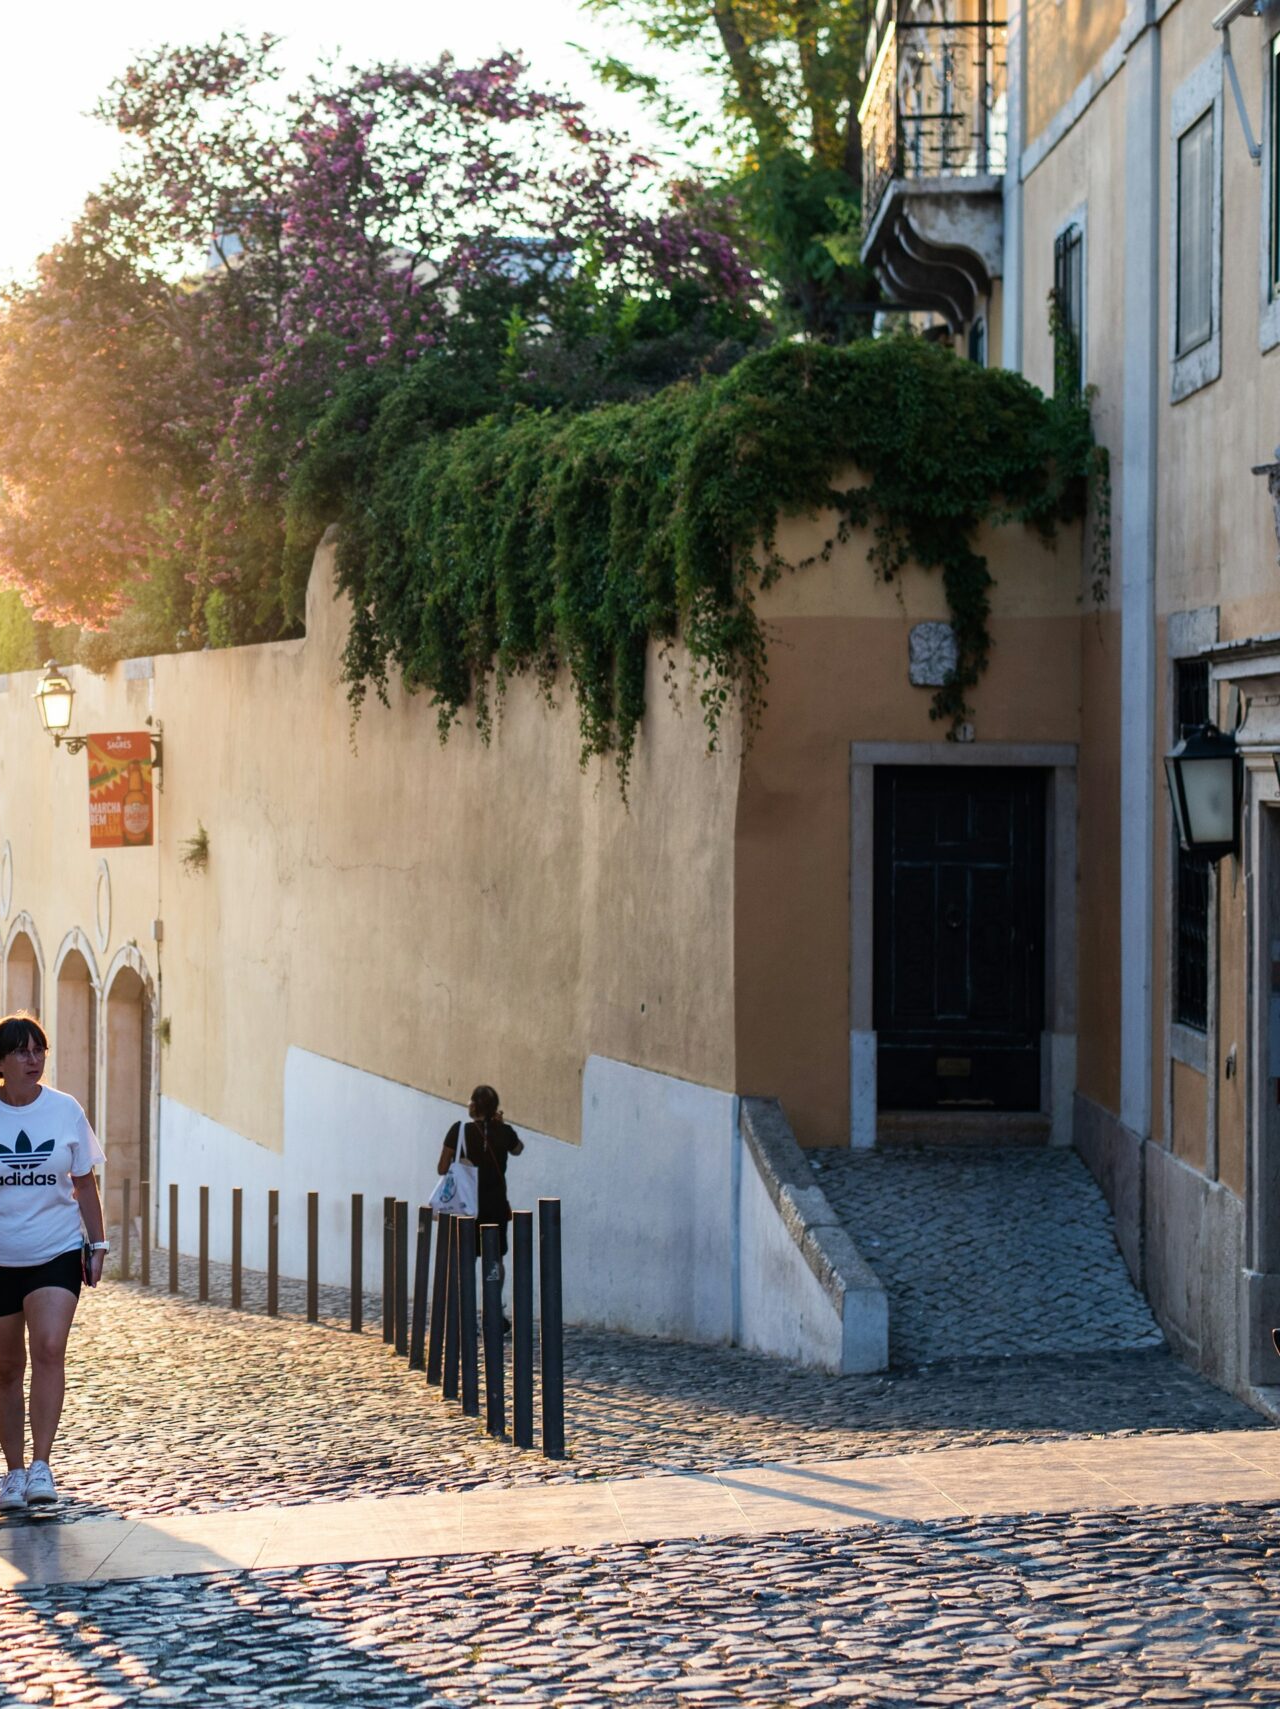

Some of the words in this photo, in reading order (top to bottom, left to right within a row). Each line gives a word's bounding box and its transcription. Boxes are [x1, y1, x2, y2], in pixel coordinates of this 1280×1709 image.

[106, 740, 132, 750] SAGRES
[89, 801, 121, 813] MARCHA
[90, 813, 107, 826] BEM
